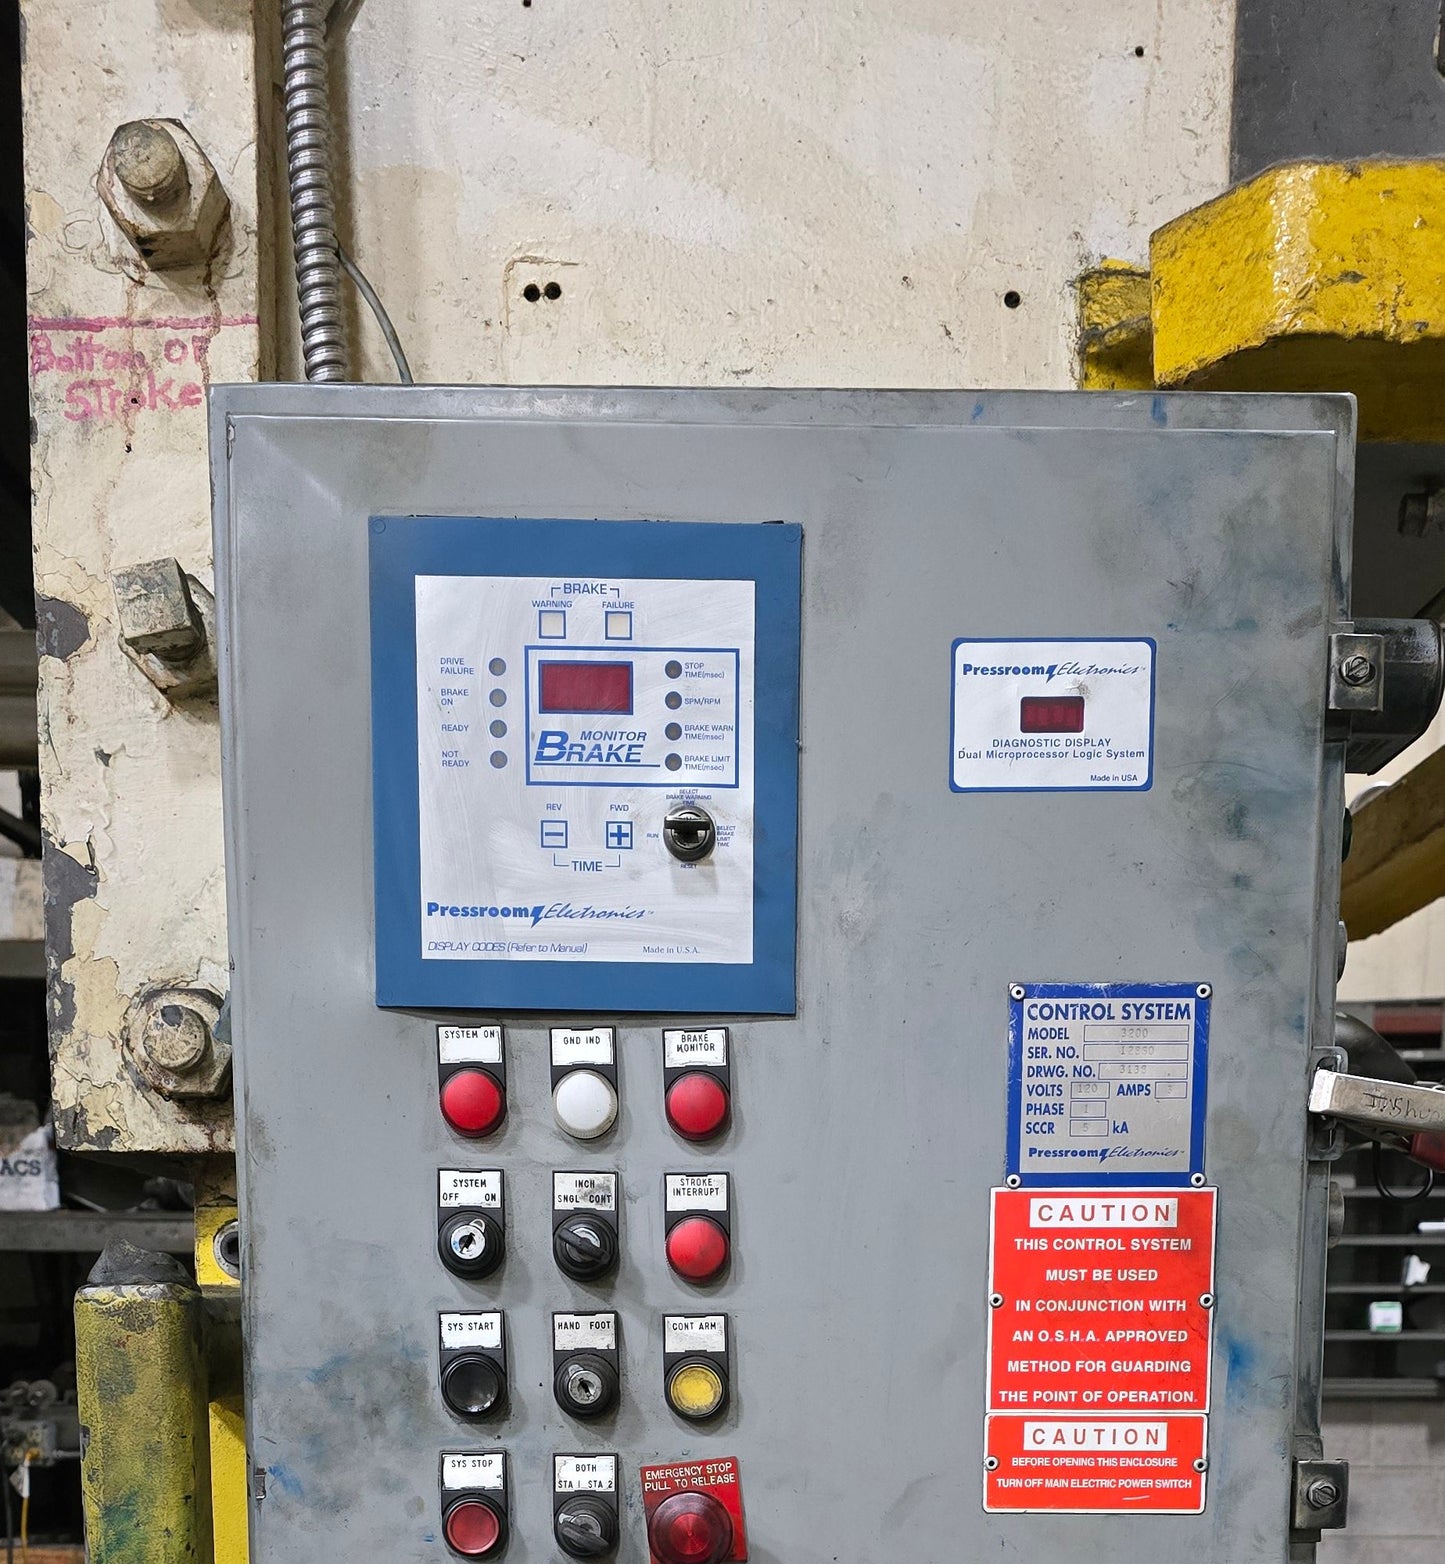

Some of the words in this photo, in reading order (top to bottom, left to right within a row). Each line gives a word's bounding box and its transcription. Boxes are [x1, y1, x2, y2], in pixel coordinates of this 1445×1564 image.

[563, 583, 608, 594] BRAKE
[602, 601, 634, 609] FAILURE
[440, 667, 474, 675] FAILURE
[963, 664, 1044, 675] Pressroom
[1057, 662, 1140, 675] Electronics
[685, 671, 724, 679] TIME(msec)
[441, 698, 453, 706] ON
[685, 697, 720, 705] SPM/RPM
[580, 731, 647, 741] MONITOR
[685, 733, 724, 741] TIME(msec)
[534, 730, 644, 763] BRAKE
[992, 739, 1060, 748] DIAGNOSTIC
[1065, 738, 1111, 747] DISPLAY
[958, 751, 981, 759] Dual
[986, 750, 1069, 760] Microprocessor
[1073, 750, 1102, 760] Logic
[1106, 750, 1144, 760] System
[1090, 774, 1110, 782] Made
[1112, 774, 1119, 782] in
[1121, 774, 1137, 782] USA
[572, 861, 602, 871] TIME
[427, 902, 529, 917] Pressroom
[544, 902, 645, 919] Electronics
[428, 942, 470, 951] DISPLAY
[472, 942, 506, 951] CODES
[507, 943, 536, 953] (Refer
[550, 943, 588, 953] Manual)
[1027, 1003, 1115, 1020] CONTROL
[1122, 1003, 1191, 1020] SYSTEM
[444, 1030, 478, 1039] SYSTEM
[484, 1030, 495, 1038] ON
[682, 1034, 708, 1042] BRAKE
[1028, 1027, 1069, 1040] MODEL
[563, 1036, 581, 1045] GND
[586, 1036, 601, 1044] IND
[677, 1043, 715, 1053] MONITOR
[1028, 1047, 1052, 1059] SER.
[1056, 1047, 1079, 1059] NO.
[1027, 1065, 1068, 1078] DRWG.
[1073, 1065, 1096, 1078] NO.
[1027, 1084, 1062, 1096] VOLTS
[1117, 1084, 1151, 1096] AMPS
[1026, 1103, 1064, 1115] PHASE
[1026, 1122, 1055, 1134] SCCR
[1113, 1121, 1129, 1134] kA
[1028, 1148, 1098, 1157] Pressroom
[1108, 1146, 1179, 1158] Electronics
[453, 1179, 486, 1187] SYSTEM
[575, 1180, 595, 1188] INCH
[680, 1178, 713, 1187] STROKE
[672, 1187, 720, 1196] INTERRUPT
[443, 1193, 459, 1201] OFF
[484, 1193, 496, 1201] ON
[558, 1195, 580, 1203] SNGL
[589, 1194, 612, 1203] CONT
[1038, 1205, 1170, 1221] CAUTION
[1014, 1239, 1048, 1250] THIS
[1053, 1239, 1126, 1250] CONTROL
[1131, 1239, 1191, 1250] SYSTEM
[1046, 1270, 1087, 1281] MUST
[1093, 1270, 1112, 1281] BE
[1118, 1270, 1158, 1281] USED
[1016, 1300, 1030, 1311] IN
[1035, 1300, 1144, 1311] CONJUNCTION
[1148, 1300, 1186, 1311] WITH
[447, 1322, 465, 1331] SYS
[468, 1321, 494, 1331] START
[557, 1321, 581, 1330] HAND
[589, 1321, 611, 1330] FOOT
[672, 1322, 694, 1331] CONT
[698, 1321, 716, 1330] ARM
[1012, 1330, 1033, 1342] AN
[1038, 1330, 1100, 1342] O.S.H.A.
[1105, 1330, 1188, 1342] APPROVED
[1008, 1361, 1070, 1372] METHOD
[1076, 1361, 1106, 1372] FOR
[1111, 1361, 1191, 1372] GUARDING
[999, 1391, 1028, 1402] THE
[1033, 1391, 1078, 1402] POINT
[1082, 1391, 1102, 1402] OF
[1107, 1391, 1198, 1402] OPERATION.
[1032, 1428, 1158, 1444] CAUTION
[451, 1460, 468, 1469] SYS
[471, 1459, 493, 1468] STOP
[1012, 1458, 1050, 1467] BEFORE
[1052, 1458, 1094, 1467] OPENING
[1096, 1458, 1118, 1467] THIS
[1120, 1458, 1178, 1467] ENCLOSURE
[576, 1464, 596, 1472] BOTH
[645, 1466, 702, 1480] EMERGENCY
[706, 1462, 732, 1474] STOP
[558, 1480, 573, 1488] STA
[588, 1480, 603, 1488] STA
[608, 1480, 613, 1488] 2
[644, 1481, 671, 1491] PULL
[675, 1478, 688, 1488] TO
[691, 1473, 736, 1486] RELEASE
[996, 1478, 1022, 1488] TURN
[1025, 1478, 1043, 1488] OFF
[1045, 1478, 1069, 1488] MAIN
[1070, 1478, 1116, 1488] ELECTRIC
[1118, 1478, 1152, 1488] POWER
[1155, 1478, 1192, 1488] SWITCH
